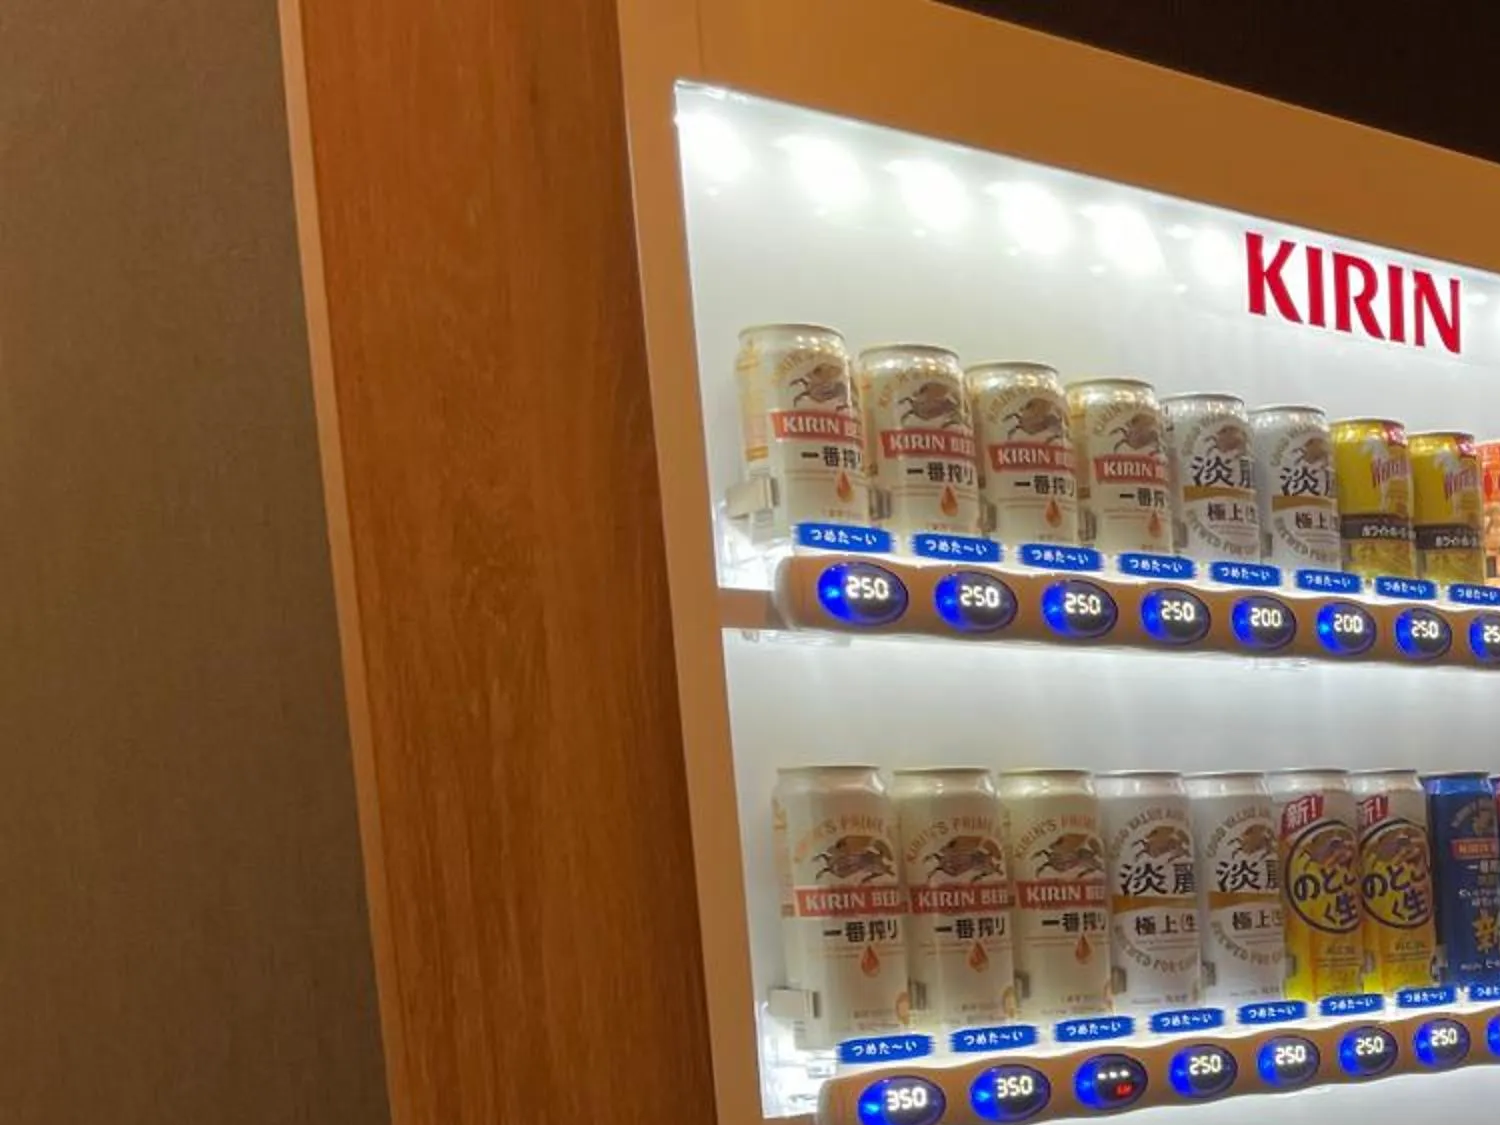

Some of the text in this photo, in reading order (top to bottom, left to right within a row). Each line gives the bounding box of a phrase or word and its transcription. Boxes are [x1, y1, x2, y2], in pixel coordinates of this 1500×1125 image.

[1245, 232, 1461, 354] KIRIN
[782, 416, 839, 435] KIRIN
[889, 434, 945, 450] KIRIN
[998, 448, 1050, 465] KIRIN
[1103, 460, 1152, 478] KIRIN
[846, 576, 889, 599] 250
[960, 585, 999, 608] 250
[1063, 592, 1101, 615] 250
[1161, 601, 1195, 622] 250
[1250, 607, 1282, 627] 200
[1333, 614, 1364, 634] 200
[1411, 620, 1440, 639] 250
[806, 892, 865, 911] KIRIN
[918, 890, 976, 907] KIRIN
[1027, 885, 1081, 903] KIRIN
[822, 919, 898, 943] 一番搾り
[935, 916, 1006, 940] 一番搾り
[1355, 1035, 1385, 1056] 250
[1430, 1028, 1458, 1047] 250
[1189, 1054, 1223, 1076] 250
[1274, 1044, 1307, 1065] 250
[996, 1075, 1034, 1099] 350
[886, 1086, 929, 1112] 350
